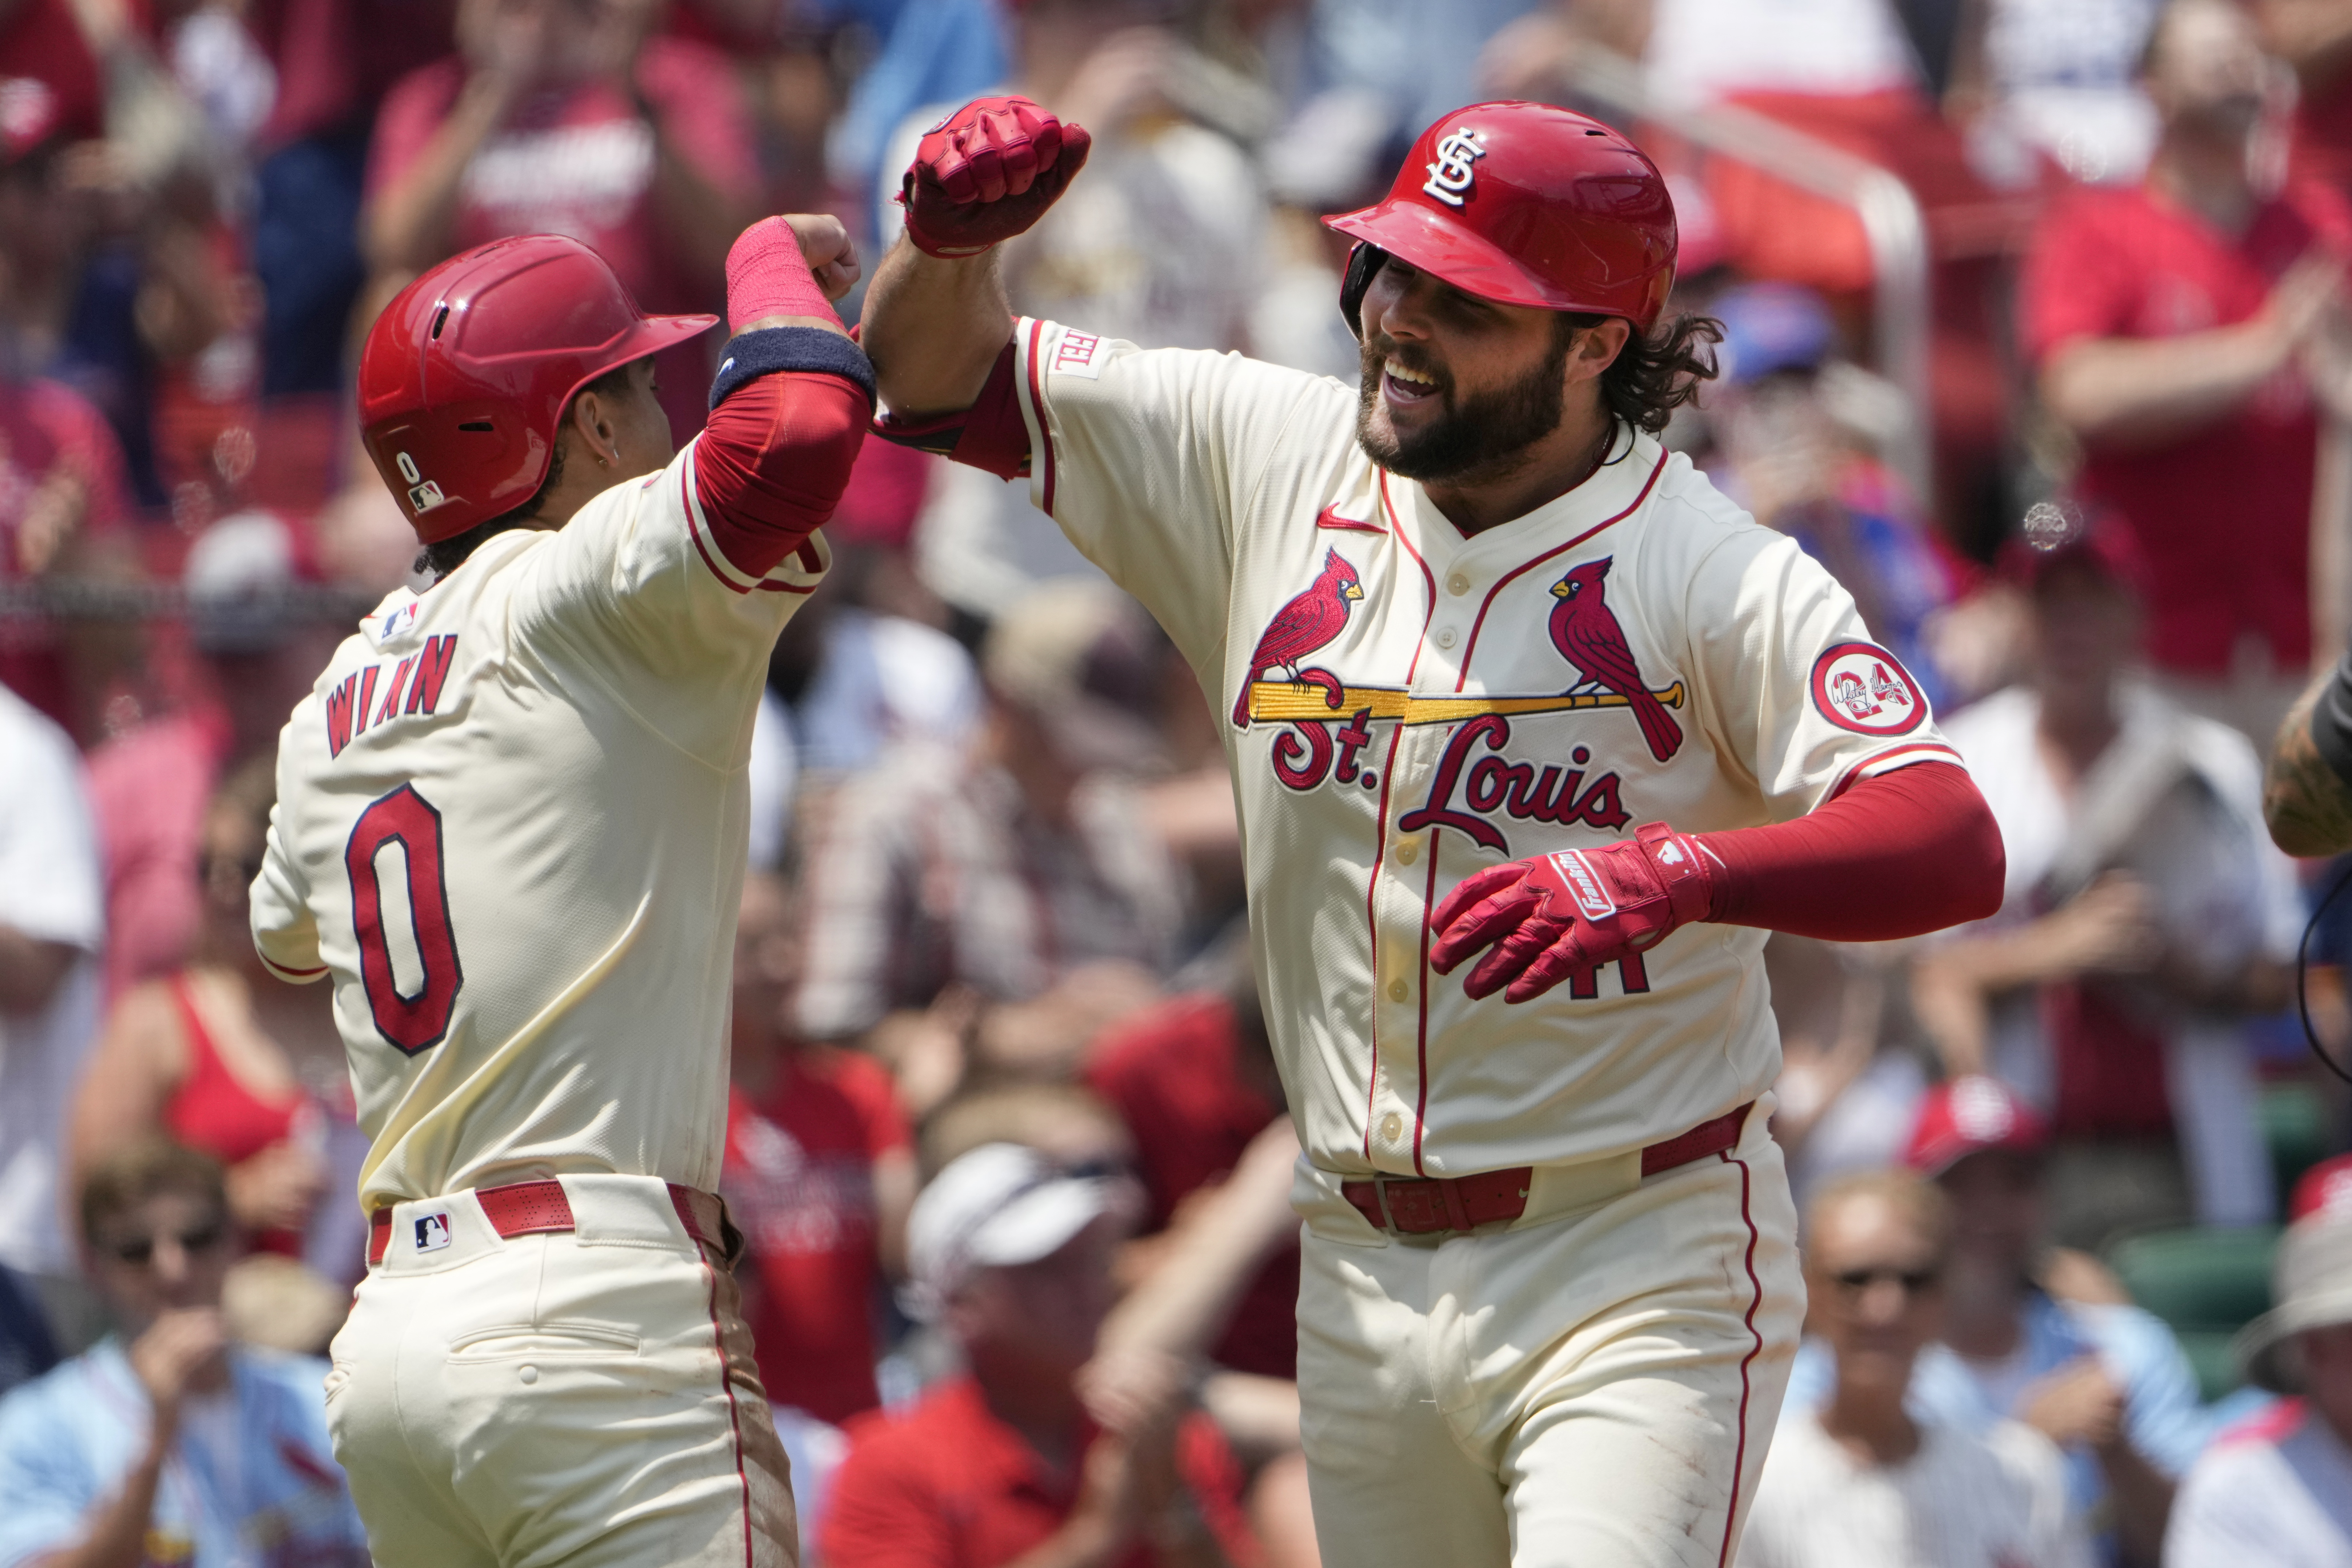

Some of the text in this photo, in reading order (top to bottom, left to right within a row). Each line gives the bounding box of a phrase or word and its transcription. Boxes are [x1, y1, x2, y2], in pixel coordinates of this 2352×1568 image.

[1055, 329, 1101, 370] FEL
[396, 451, 420, 484] 0
[1833, 663, 1909, 720] 24
[1272, 707, 1632, 858] St. Louis
[1558, 853, 1611, 910] Franklin
[345, 781, 464, 1057] 0
